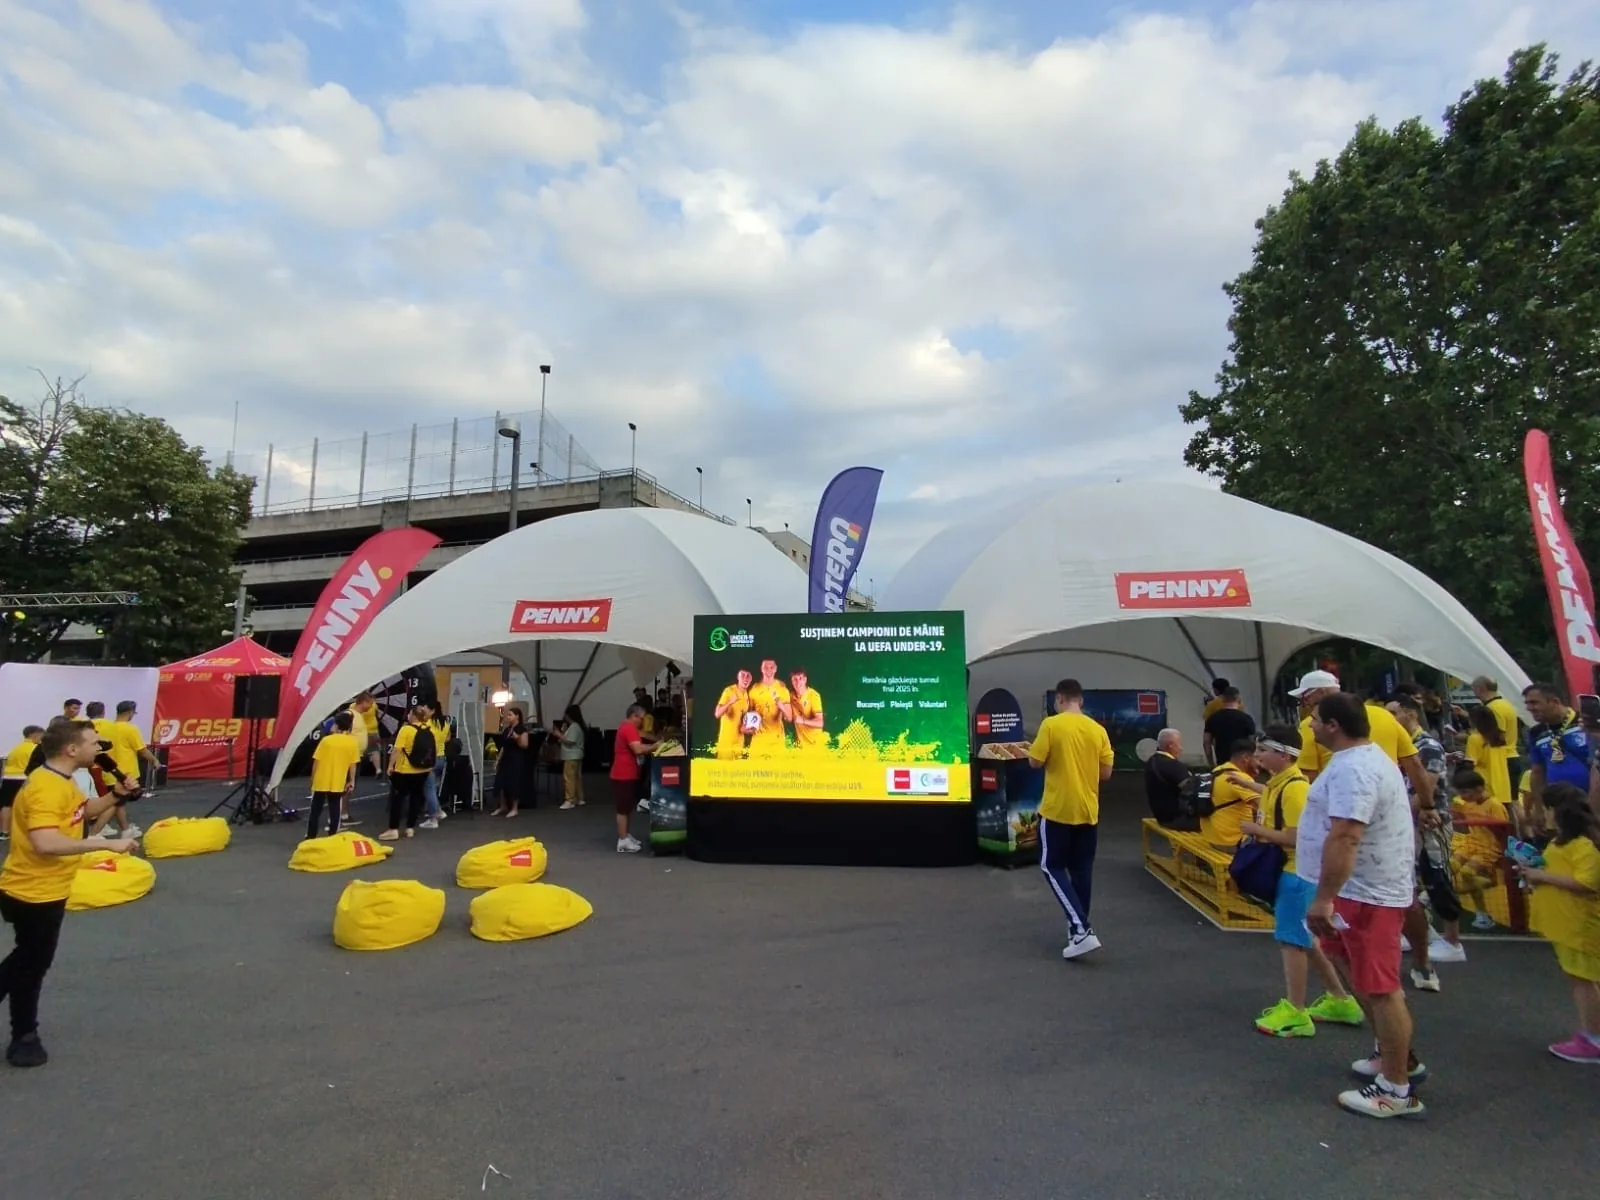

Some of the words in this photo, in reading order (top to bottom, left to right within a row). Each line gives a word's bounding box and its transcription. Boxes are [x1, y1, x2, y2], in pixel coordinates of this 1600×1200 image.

[846, 626, 897, 637] CAMPIONII
[899, 626, 911, 637] DE
[913, 624, 945, 637] MÂINE
[855, 642, 866, 652] LA
[868, 641, 892, 652] UEFA
[408, 678, 419, 688] 13
[411, 695, 418, 705] 6
